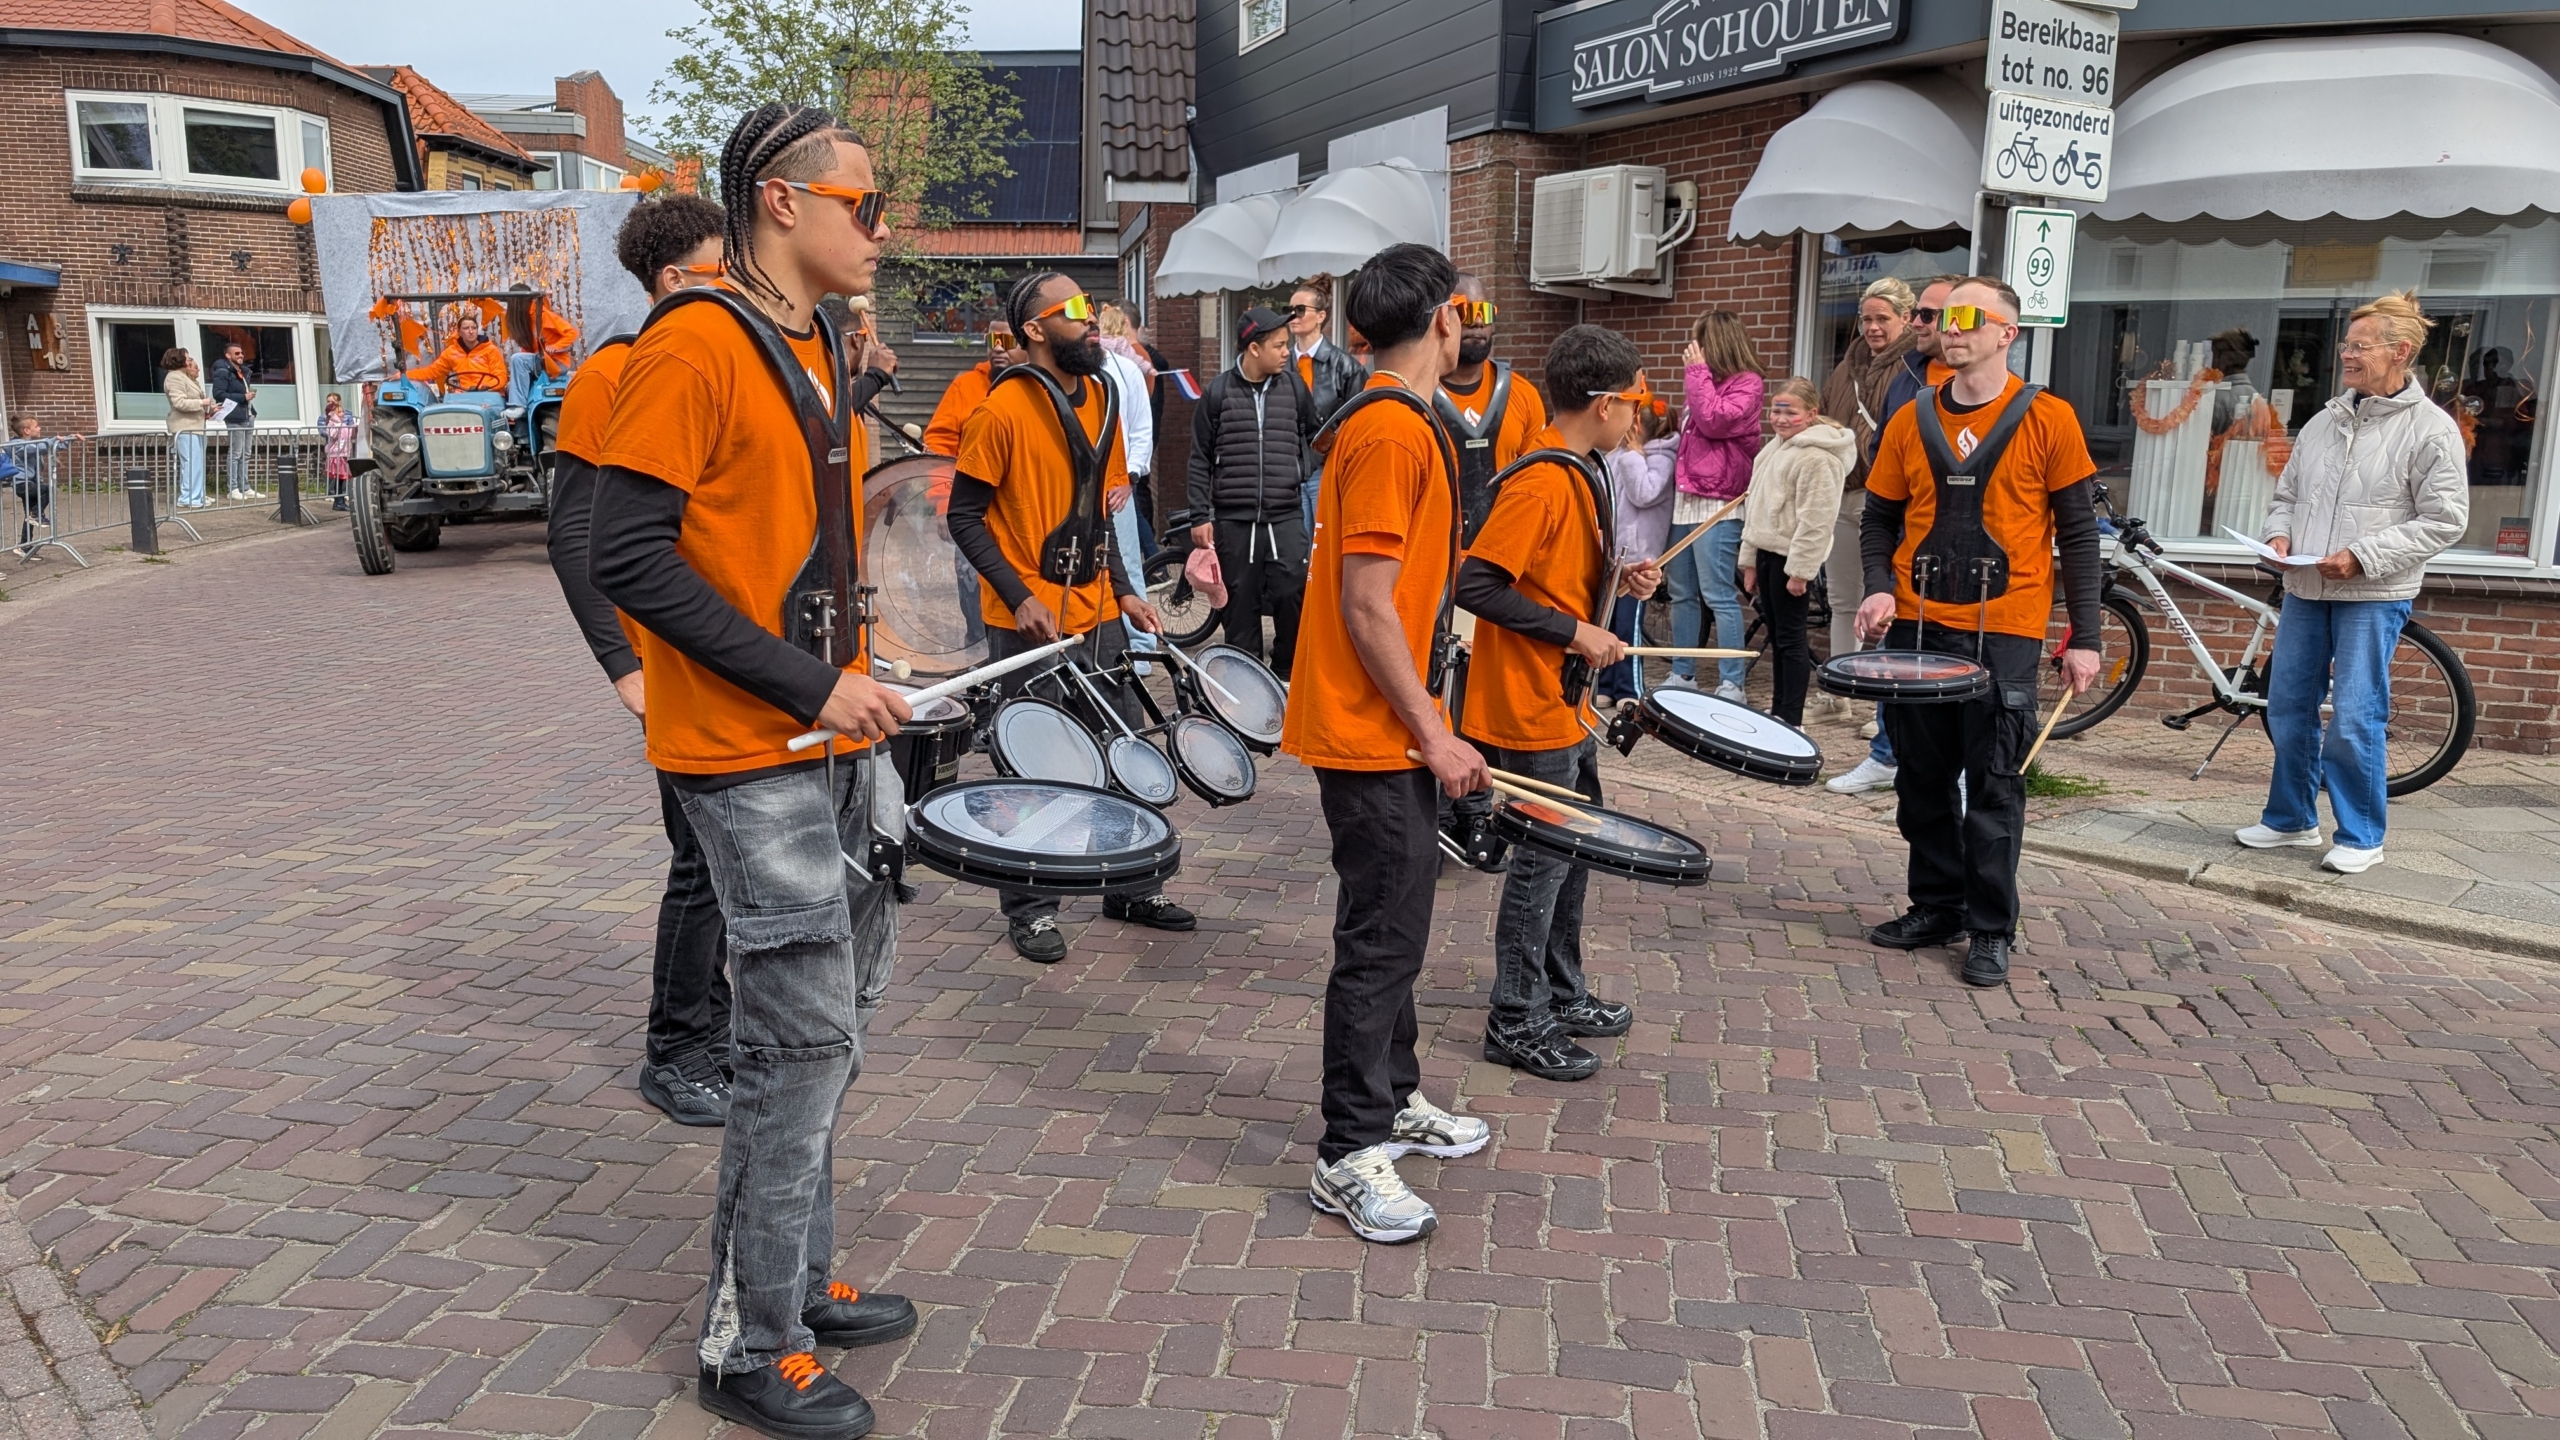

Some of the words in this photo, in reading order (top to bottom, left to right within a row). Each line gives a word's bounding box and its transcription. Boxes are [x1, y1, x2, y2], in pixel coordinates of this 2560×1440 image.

[2000, 10, 2116, 56] Bereikbaar
[1572, 28, 1674, 92] SALON
[1686, 71, 1715, 86] SINDS
[1718, 66, 1738, 80] 1922
[2001, 53, 2034, 85] tot
[2043, 65, 2073, 91] no.
[2082, 64, 2109, 96] 96
[1999, 98, 2110, 136] uitgezonderd
[2029, 257, 2051, 277] 99
[43, 351, 68, 370] 19
[2150, 588, 2199, 646] VOLARE
